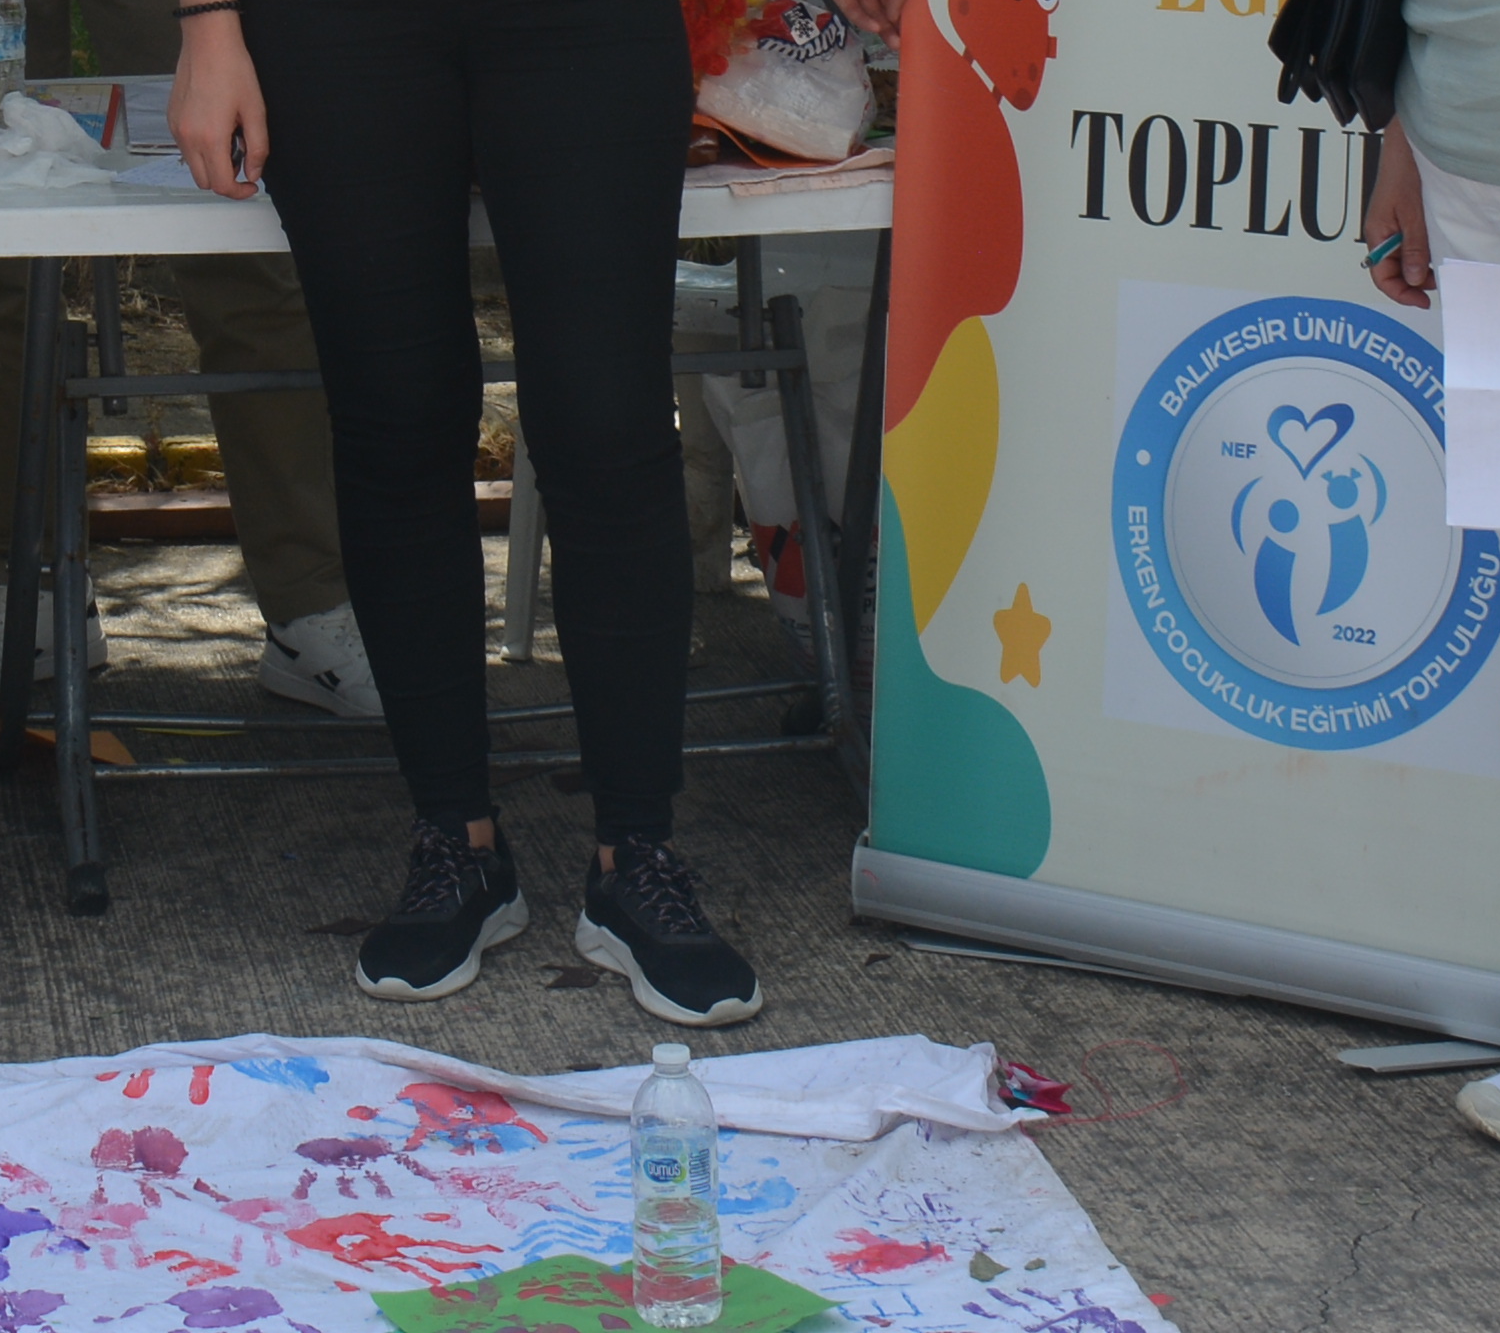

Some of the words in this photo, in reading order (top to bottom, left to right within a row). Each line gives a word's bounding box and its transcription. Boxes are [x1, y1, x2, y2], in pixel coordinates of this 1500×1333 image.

[1070, 109, 1385, 244] TOPLU
[1159, 317, 1286, 418] BALIKESİR
[1220, 440, 1258, 460] NEF
[1127, 505, 1166, 609] ERKEN
[1152, 609, 1286, 729] ÇOCUKLUK
[1289, 690, 1393, 735] EĞİTİMİ
[1331, 624, 1377, 646] 2022
